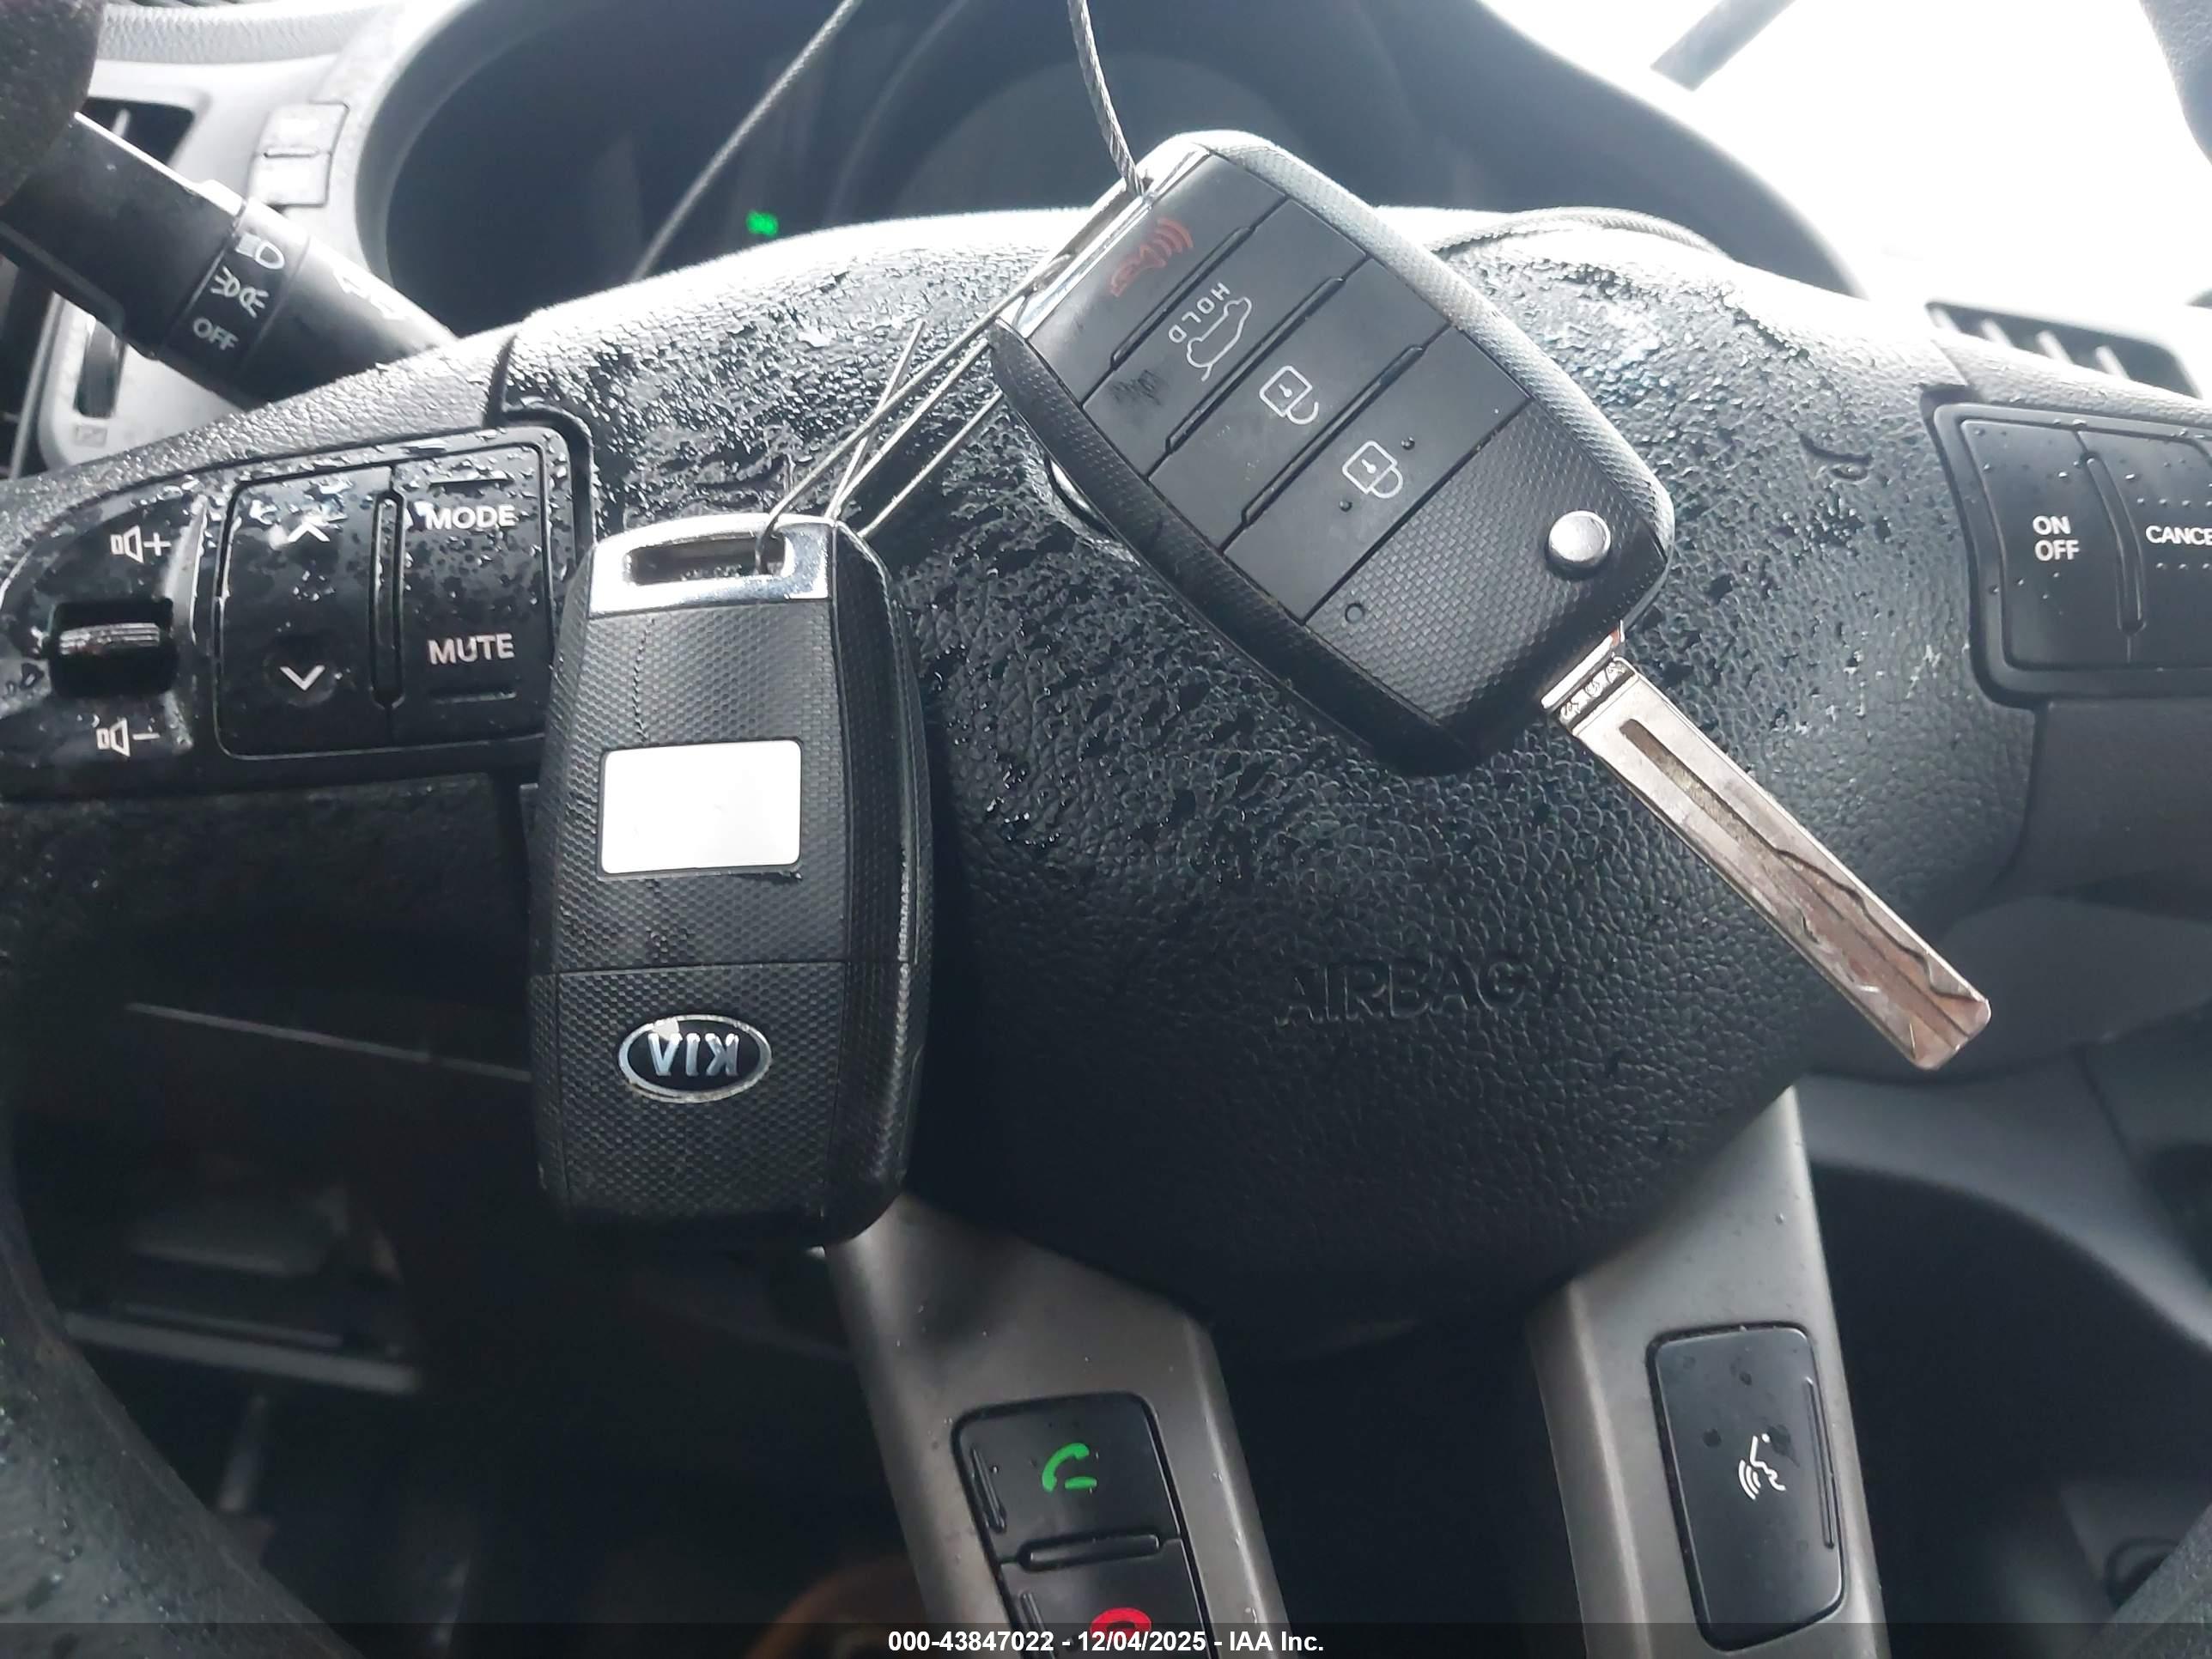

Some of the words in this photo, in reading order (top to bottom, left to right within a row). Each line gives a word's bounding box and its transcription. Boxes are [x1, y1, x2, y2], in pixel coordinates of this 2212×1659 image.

[1169, 282, 1231, 343] HOLD
[192, 317, 240, 350] OFF
[425, 504, 518, 530] MODE
[2033, 515, 2071, 535] ON
[2034, 539, 2080, 562] OFF
[428, 633, 515, 665] MUTE
[1274, 957, 1532, 1026] AIRBAG
[647, 1032, 739, 1077] KIA
